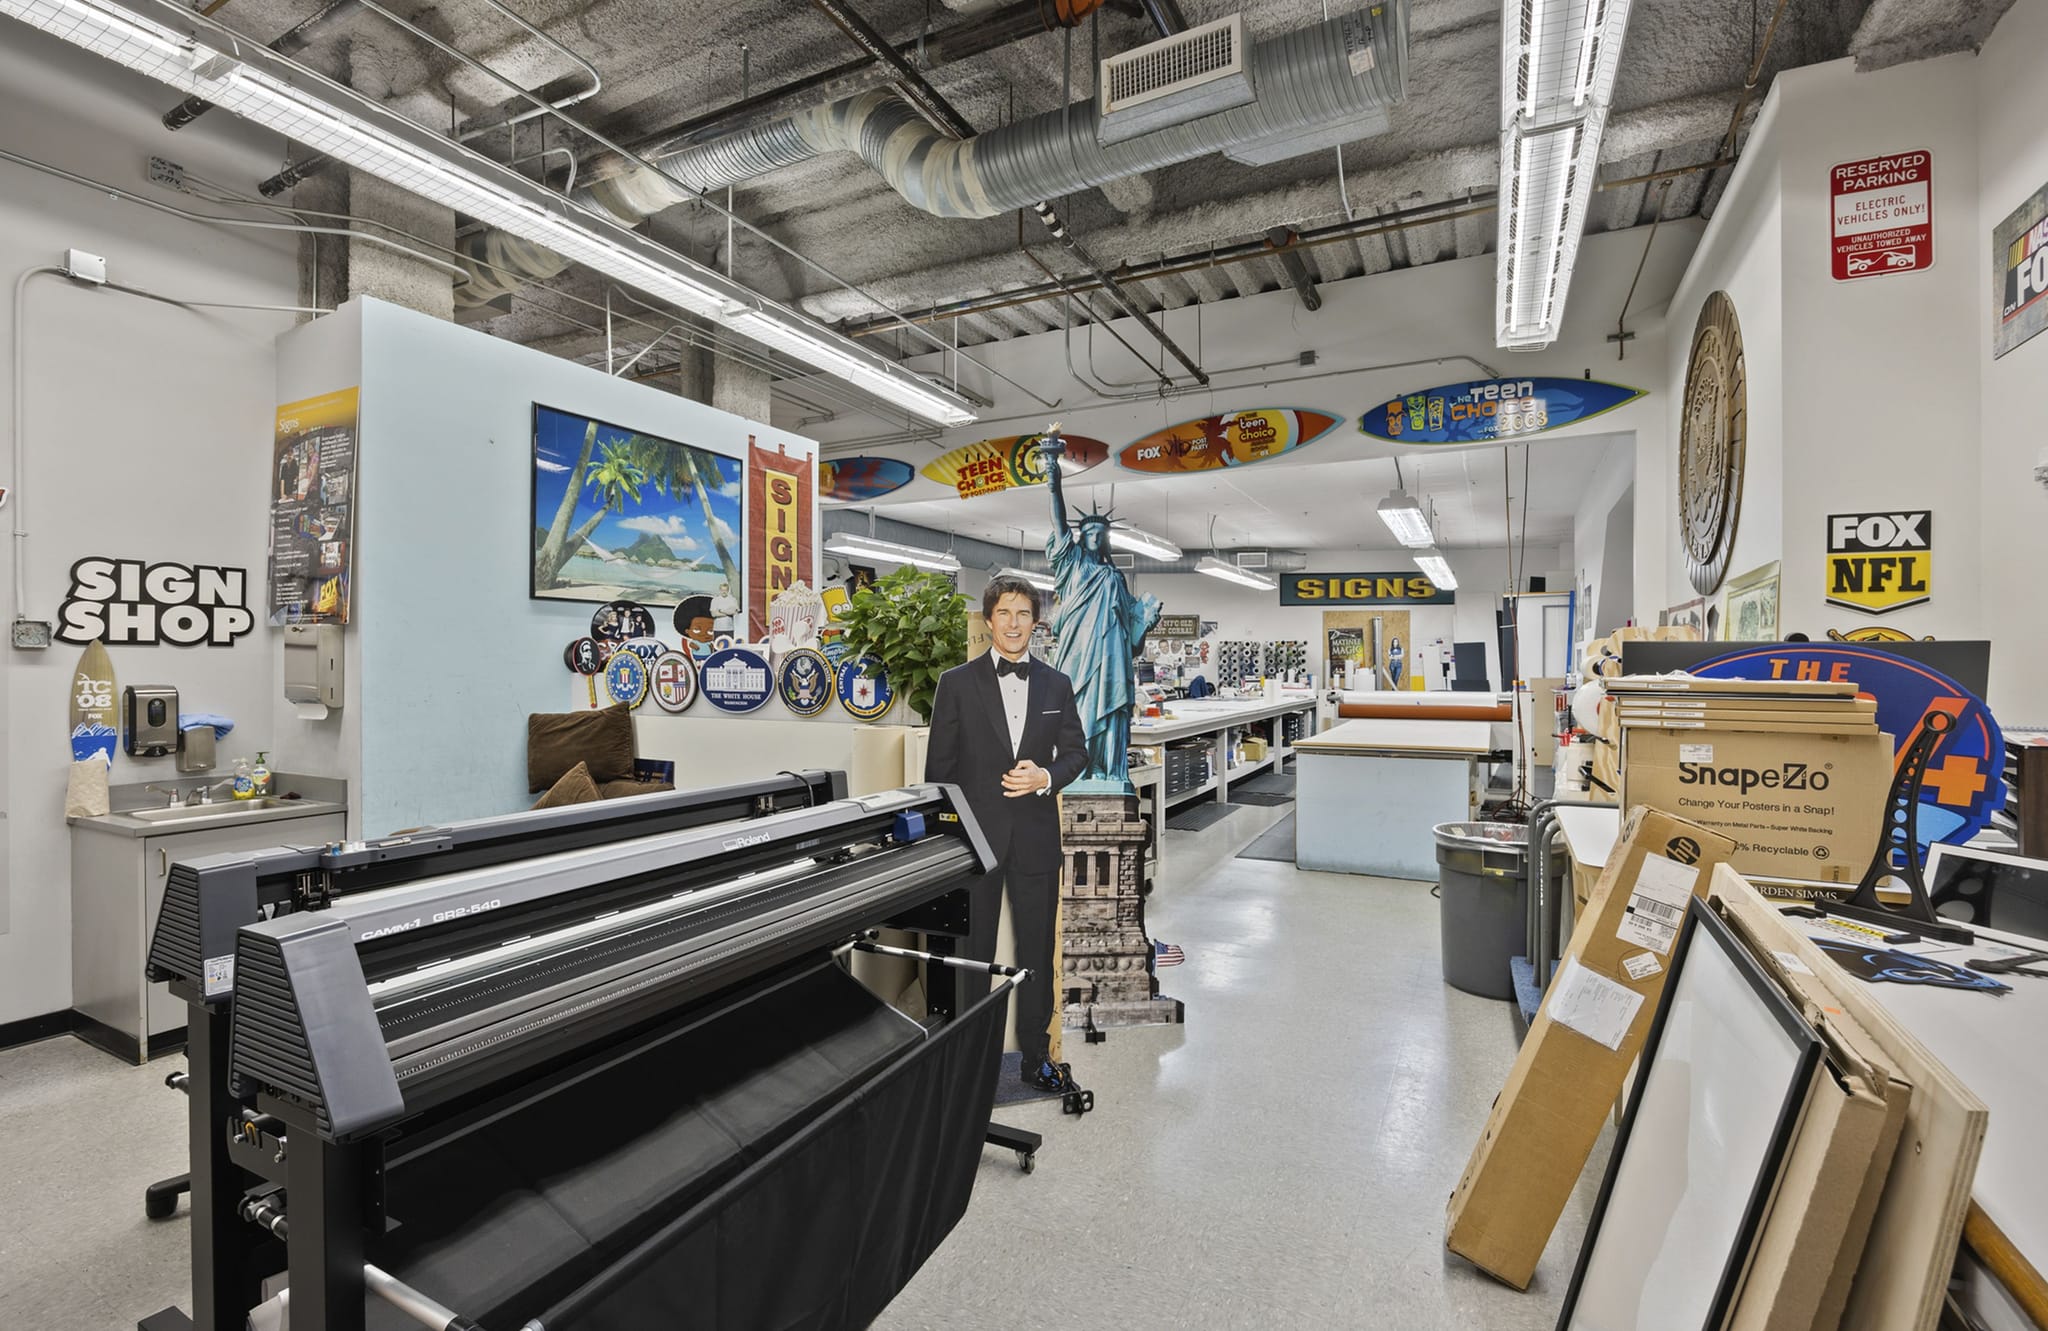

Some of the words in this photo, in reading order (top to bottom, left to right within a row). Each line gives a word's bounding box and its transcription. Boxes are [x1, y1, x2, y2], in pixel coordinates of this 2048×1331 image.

[1836, 154, 1925, 179] RESERVED
[1843, 169, 1918, 191] PARKING
[1855, 195, 1906, 211] ELECTRIC
[1837, 210, 1888, 226] VEHICLES
[1894, 204, 1925, 217] ONLY!
[1836, 242, 1874, 253] VEHICLES
[1876, 237, 1902, 247] TOWED
[1904, 233, 1927, 243] AWAY
[1851, 228, 1911, 244] UNAUTHORIZED
[2016, 245, 2048, 308] FO
[1240, 417, 1266, 429] teen
[1192, 437, 1207, 445] POST
[1241, 427, 1275, 441] choice
[1137, 446, 1161, 460] FOX
[1191, 443, 1209, 452] PARTY
[957, 457, 1002, 480] TEEN
[957, 472, 1005, 491] CHOICE
[769, 478, 794, 602] SIGN
[1832, 513, 1927, 549] FOX
[73, 560, 243, 606] SIGN
[1832, 557, 1926, 593] NFL
[320, 576, 338, 600] FOX
[1296, 578, 1436, 599] SIGNS
[61, 600, 251, 643] SHOP
[1331, 645, 1362, 656] MAGIC
[1769, 658, 1851, 683] THE
[77, 673, 112, 694] TC
[1678, 797, 1715, 809] Change
[1717, 799, 1740, 810] Your
[1742, 801, 1780, 812] Posters
[1782, 803, 1791, 812] in
[1793, 805, 1801, 813] a
[1803, 805, 1835, 816] Snap!
[1696, 819, 1724, 828] Warranty
[1732, 821, 1749, 829] Metal
[1770, 824, 1788, 832] Super
[1790, 825, 1807, 833] White
[1808, 826, 1833, 835] Backing
[737, 832, 771, 848] Roland
[1752, 843, 1809, 856] Recyclable
[1796, 889, 1837, 900] SIMMS
[361, 918, 422, 940] CAMM-1
[433, 899, 501, 922] GR2-540
